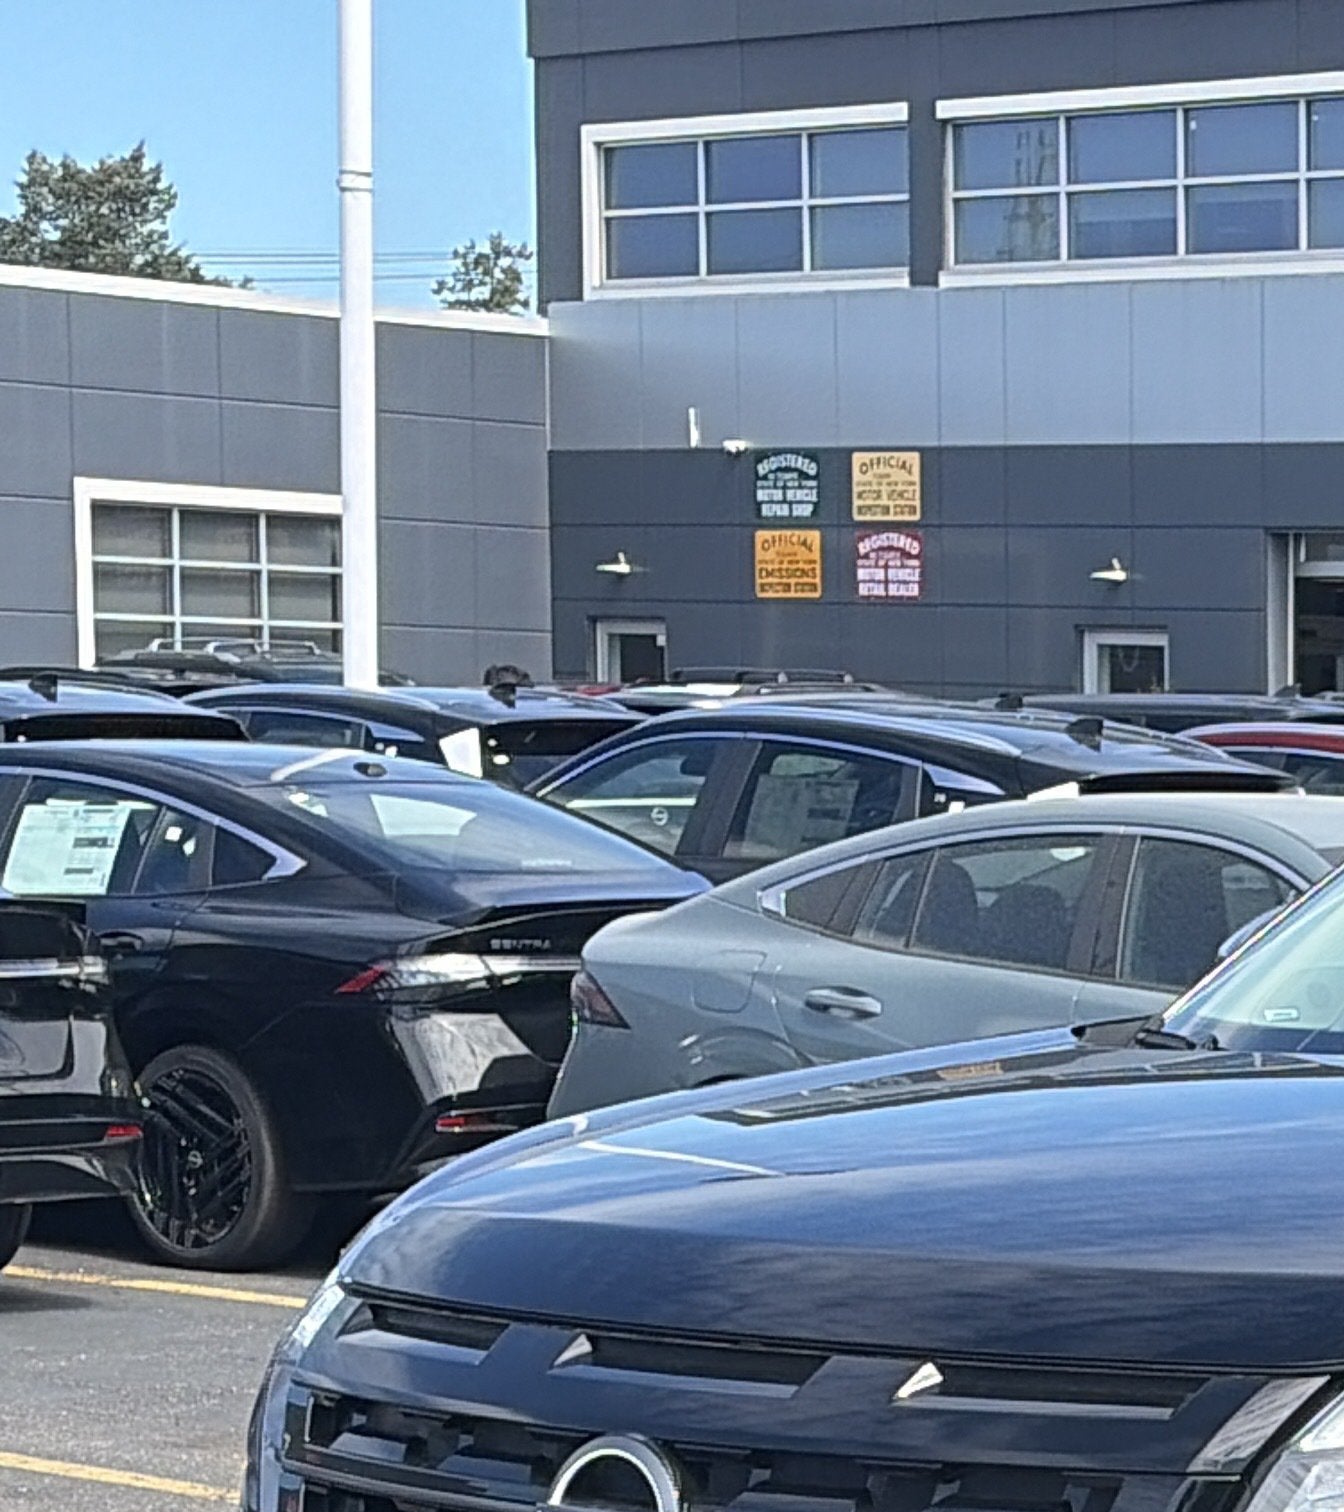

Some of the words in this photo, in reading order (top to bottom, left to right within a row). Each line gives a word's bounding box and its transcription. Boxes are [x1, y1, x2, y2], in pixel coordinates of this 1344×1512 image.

[757, 453, 818, 477] REGISTERED
[859, 455, 914, 476] OFFICIAL
[761, 534, 814, 552] OFFICIAL
[857, 532, 920, 557] REGISTERED
[758, 567, 817, 580] EMISSIONS
[490, 937, 552, 951] SENTRA
